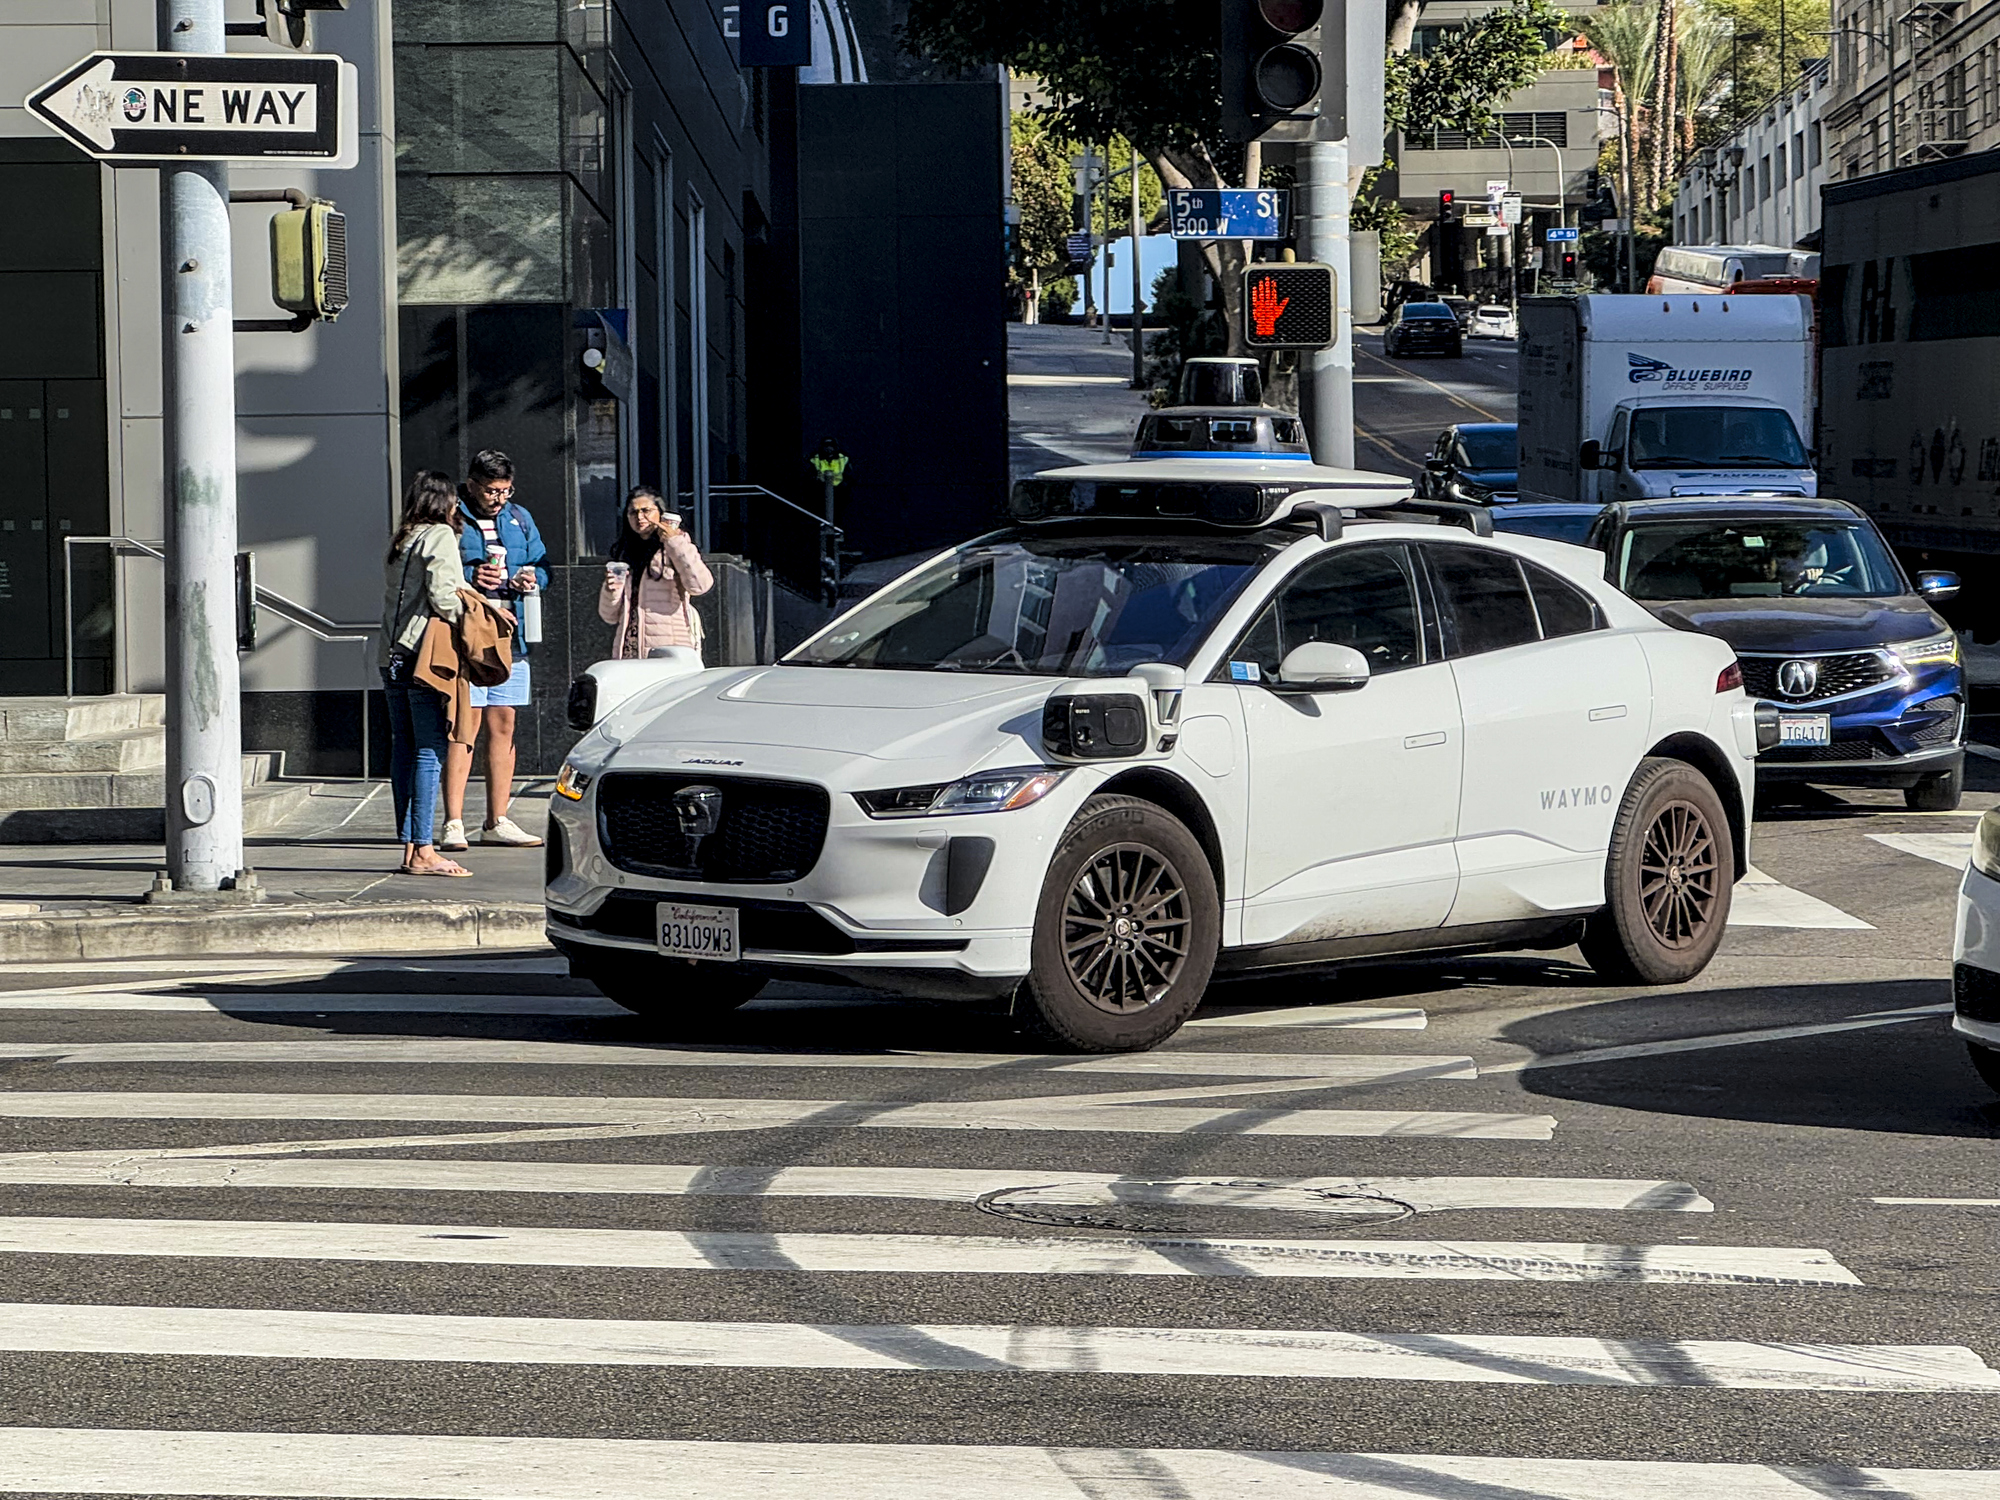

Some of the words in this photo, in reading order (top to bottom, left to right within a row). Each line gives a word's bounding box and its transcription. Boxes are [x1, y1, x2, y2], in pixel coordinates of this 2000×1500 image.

[767, 5, 788, 37] G
[221, 89, 306, 124] WAY
[1176, 192, 1203, 217] 5th
[1257, 192, 1282, 218] St
[1176, 218, 1208, 235] 500
[1216, 217, 1229, 235] W
[1662, 382, 1698, 390] OFFICE
[1703, 382, 1749, 390] SUPPLIES
[1665, 370, 1752, 381] BLUEBIRD
[1786, 726, 1825, 742] TG417
[681, 758, 744, 766] JAGUAR
[1540, 785, 1612, 810] WAYMO
[662, 923, 732, 952] 83109W3
